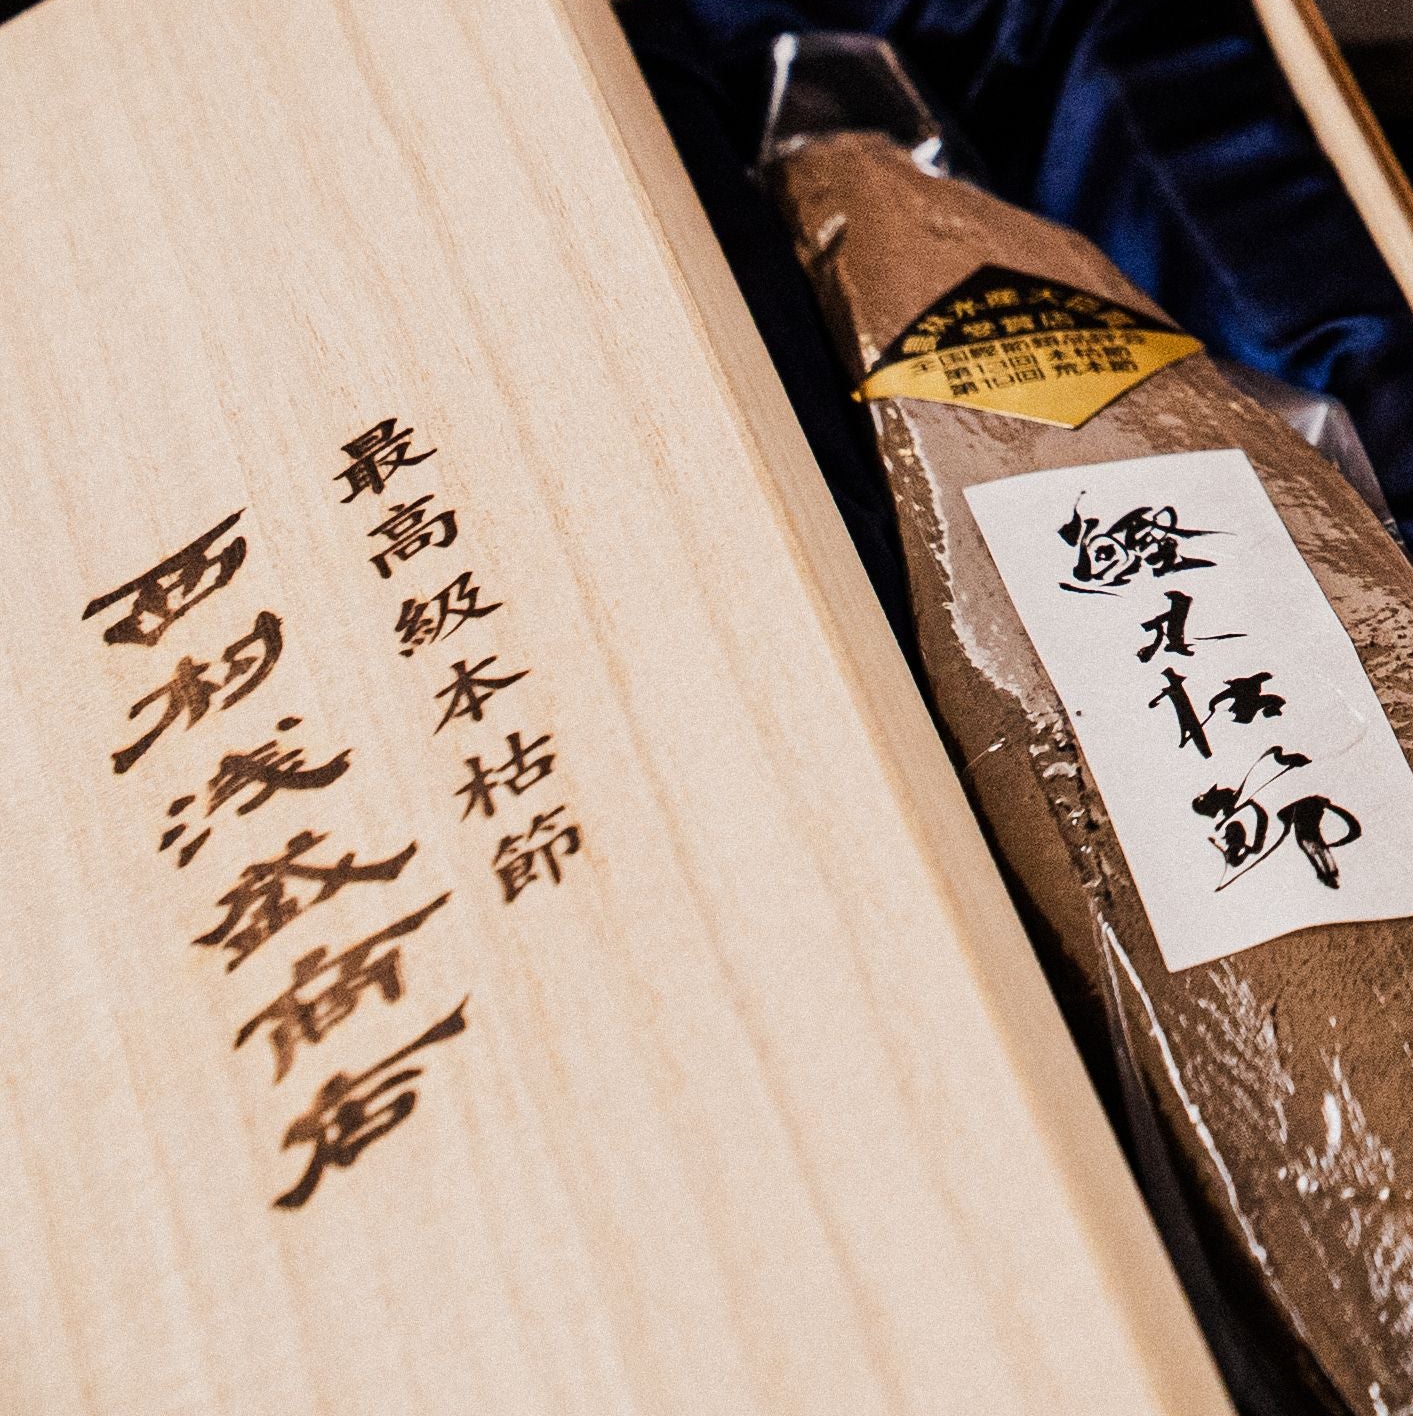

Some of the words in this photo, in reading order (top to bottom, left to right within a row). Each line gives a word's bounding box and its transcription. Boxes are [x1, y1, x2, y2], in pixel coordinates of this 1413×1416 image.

[338, 417, 584, 906] 最高級本枯節
